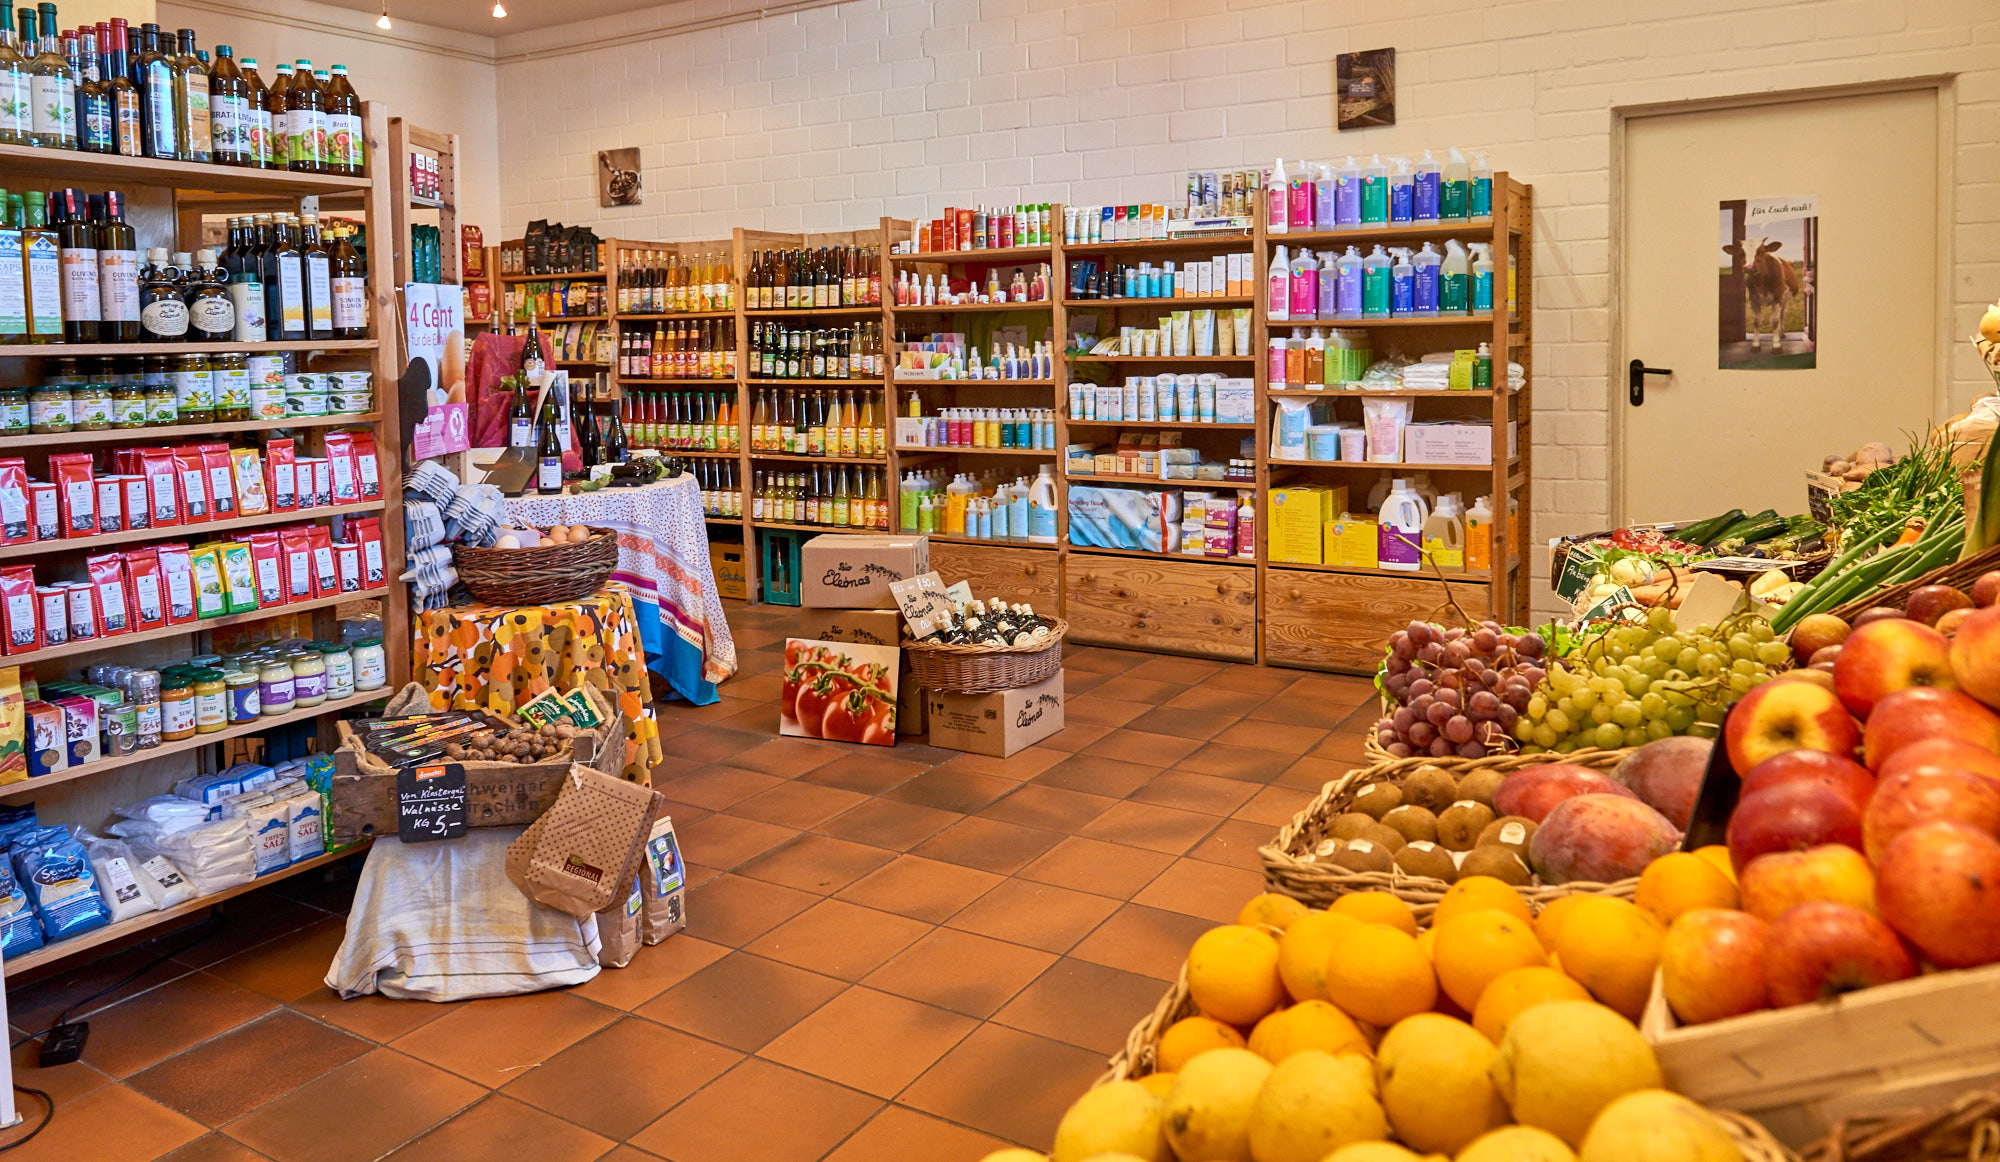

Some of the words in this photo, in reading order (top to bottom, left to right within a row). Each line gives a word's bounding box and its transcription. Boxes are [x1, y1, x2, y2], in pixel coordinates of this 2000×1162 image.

[1752, 207, 1765, 217] für
[1768, 204, 1789, 213] Euch
[1790, 202, 1811, 212] nah!
[32, 265, 57, 273] RAPS
[410, 303, 419, 328] 4
[422, 303, 453, 328] Cent
[178, 709, 193, 717] SENF
[418, 769, 443, 779] demeter
[401, 802, 461, 816] Walnüsse
[413, 819, 430, 829] KG
[297, 825, 319, 837] SALZ
[263, 837, 286, 850] SALZ
[565, 864, 599, 882] REGIONAL
